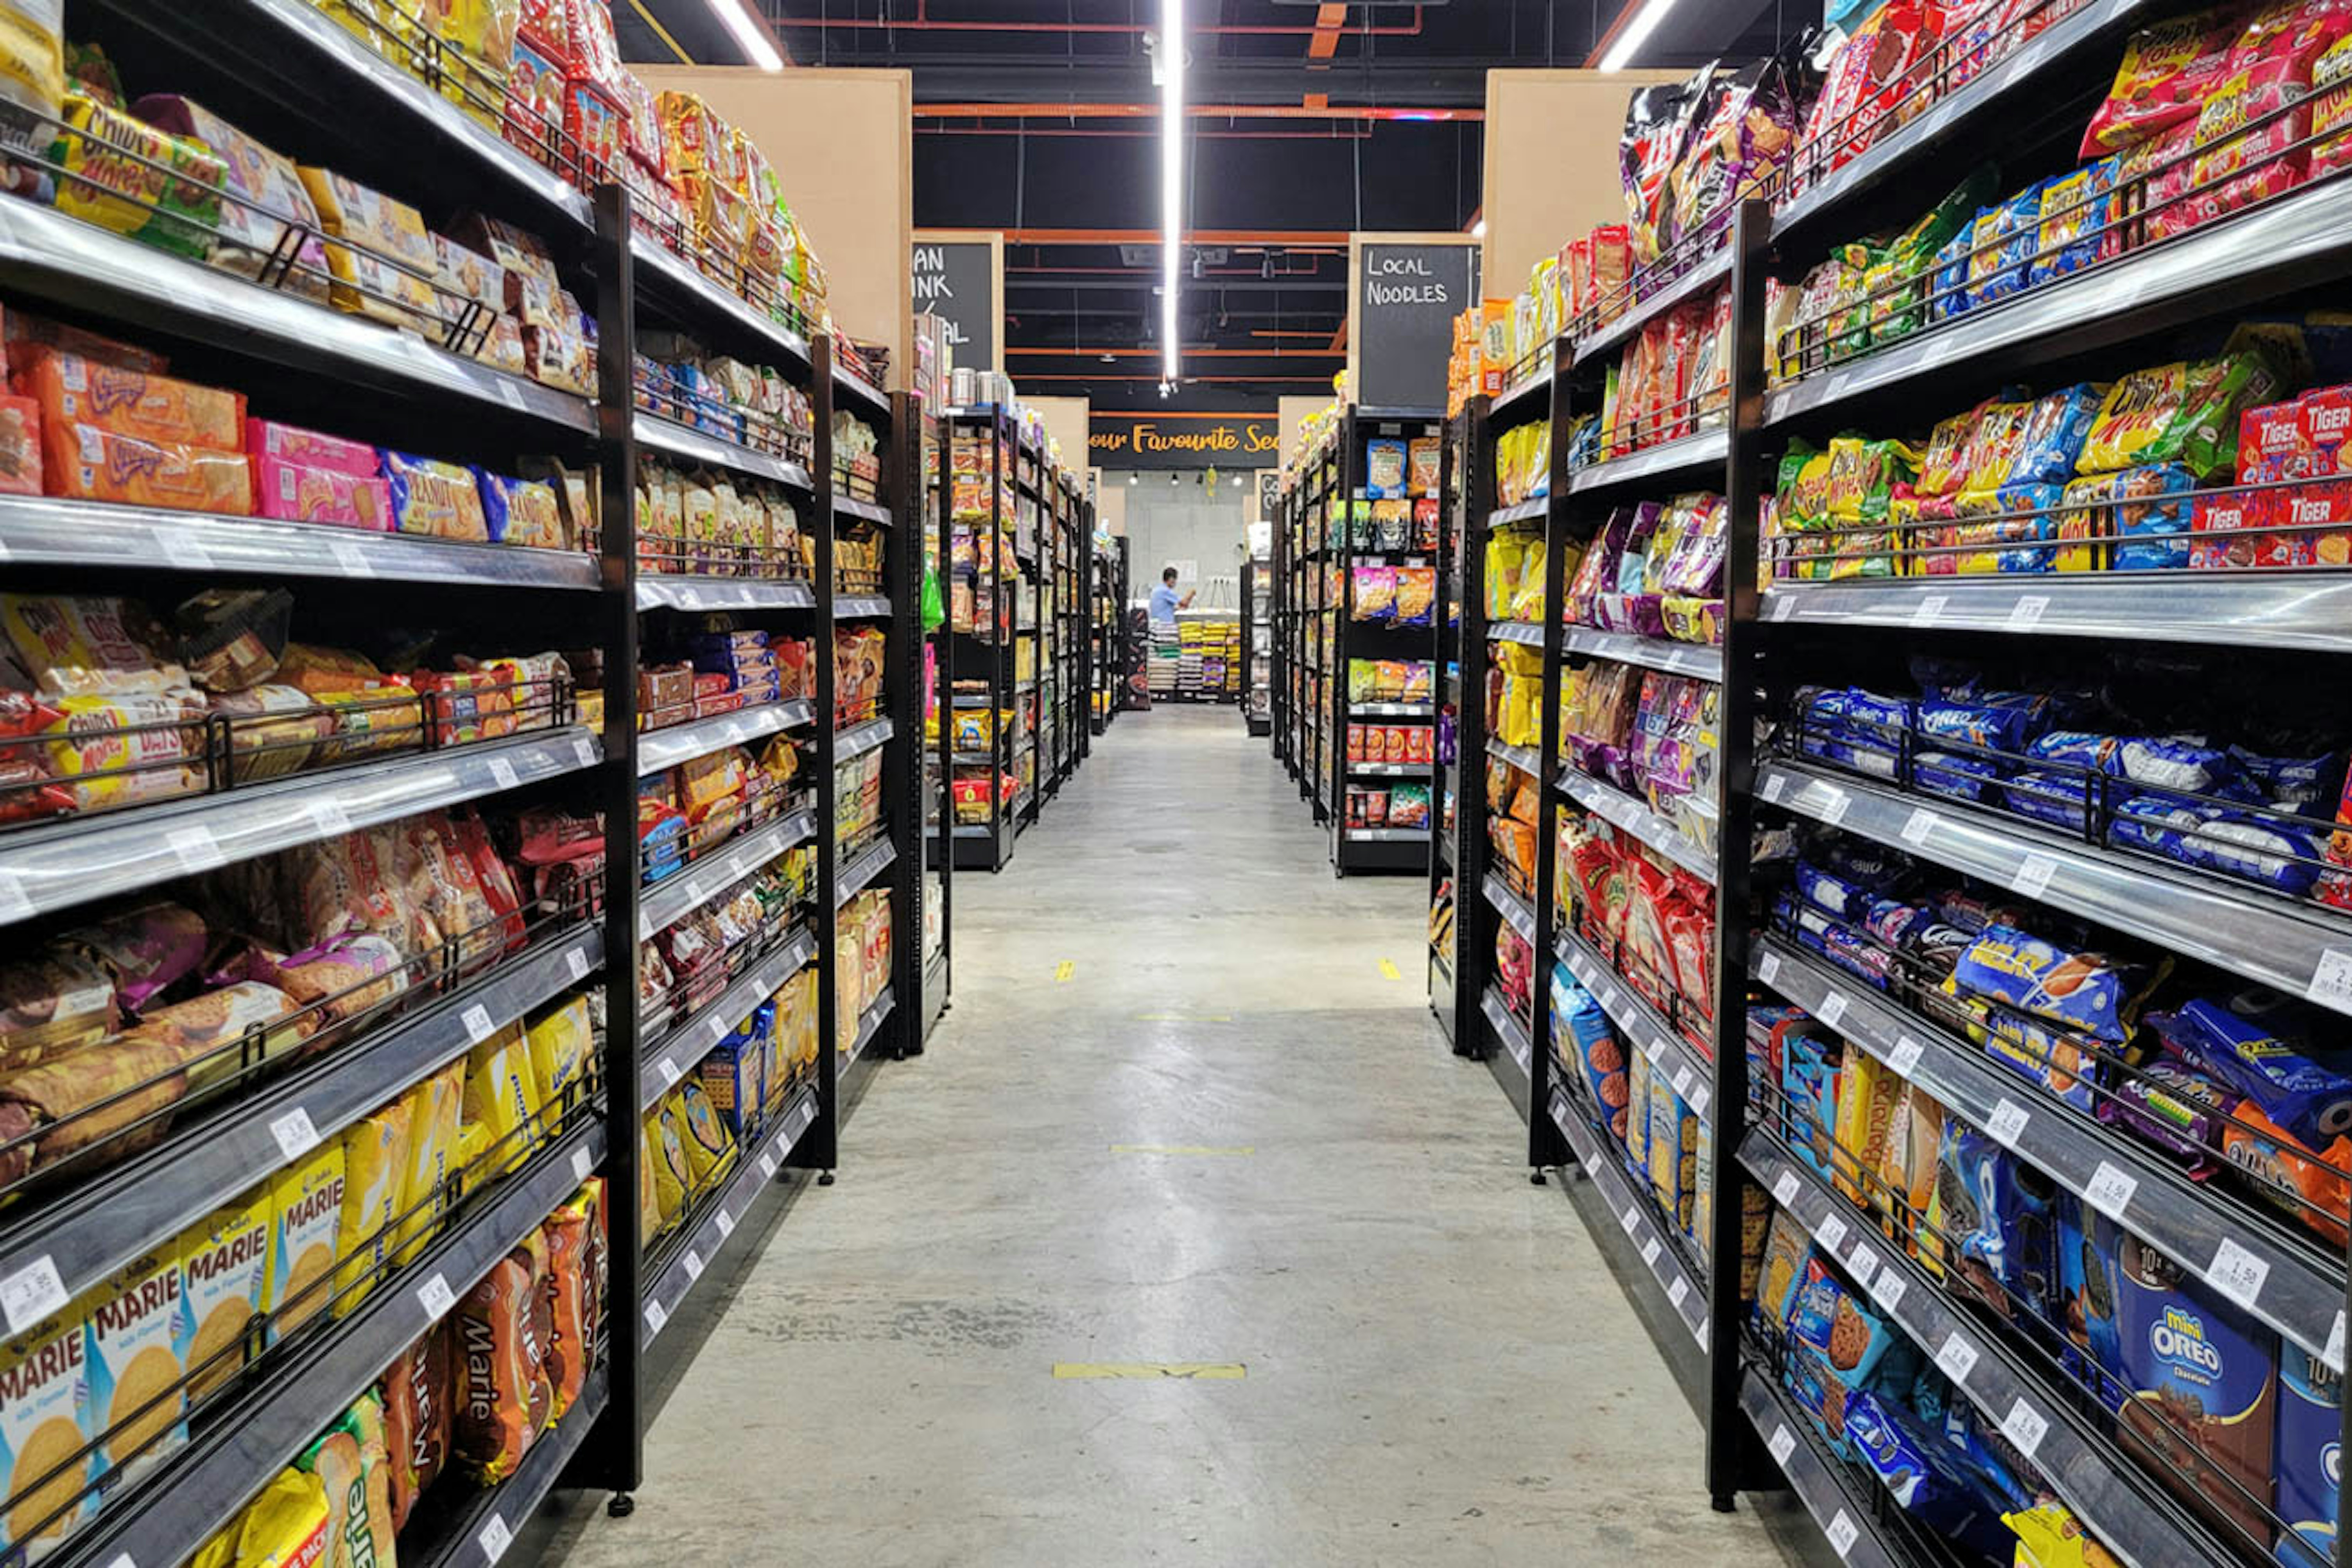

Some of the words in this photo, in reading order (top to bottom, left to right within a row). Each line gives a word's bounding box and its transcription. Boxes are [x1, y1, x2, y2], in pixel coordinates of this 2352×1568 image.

[1368, 250, 1433, 276] LOCAL
[1368, 280, 1448, 305] NOODLES
[1133, 423, 1239, 453] Favourite
[2206, 507, 2242, 530] TiGER
[2290, 496, 2331, 523] TiGER
[1862, 1078, 1891, 1166] Banana
[287, 1177, 344, 1236] MARIE
[188, 1225, 266, 1289] MARIE
[95, 1267, 179, 1340] MARIE
[2166, 1311, 2202, 1341] mini
[2153, 1325, 2219, 1371] OREO
[0, 1330, 83, 1411] MARIE
[463, 1315, 500, 1421] Marie
[2173, 1366, 2211, 1387] Chocolate
